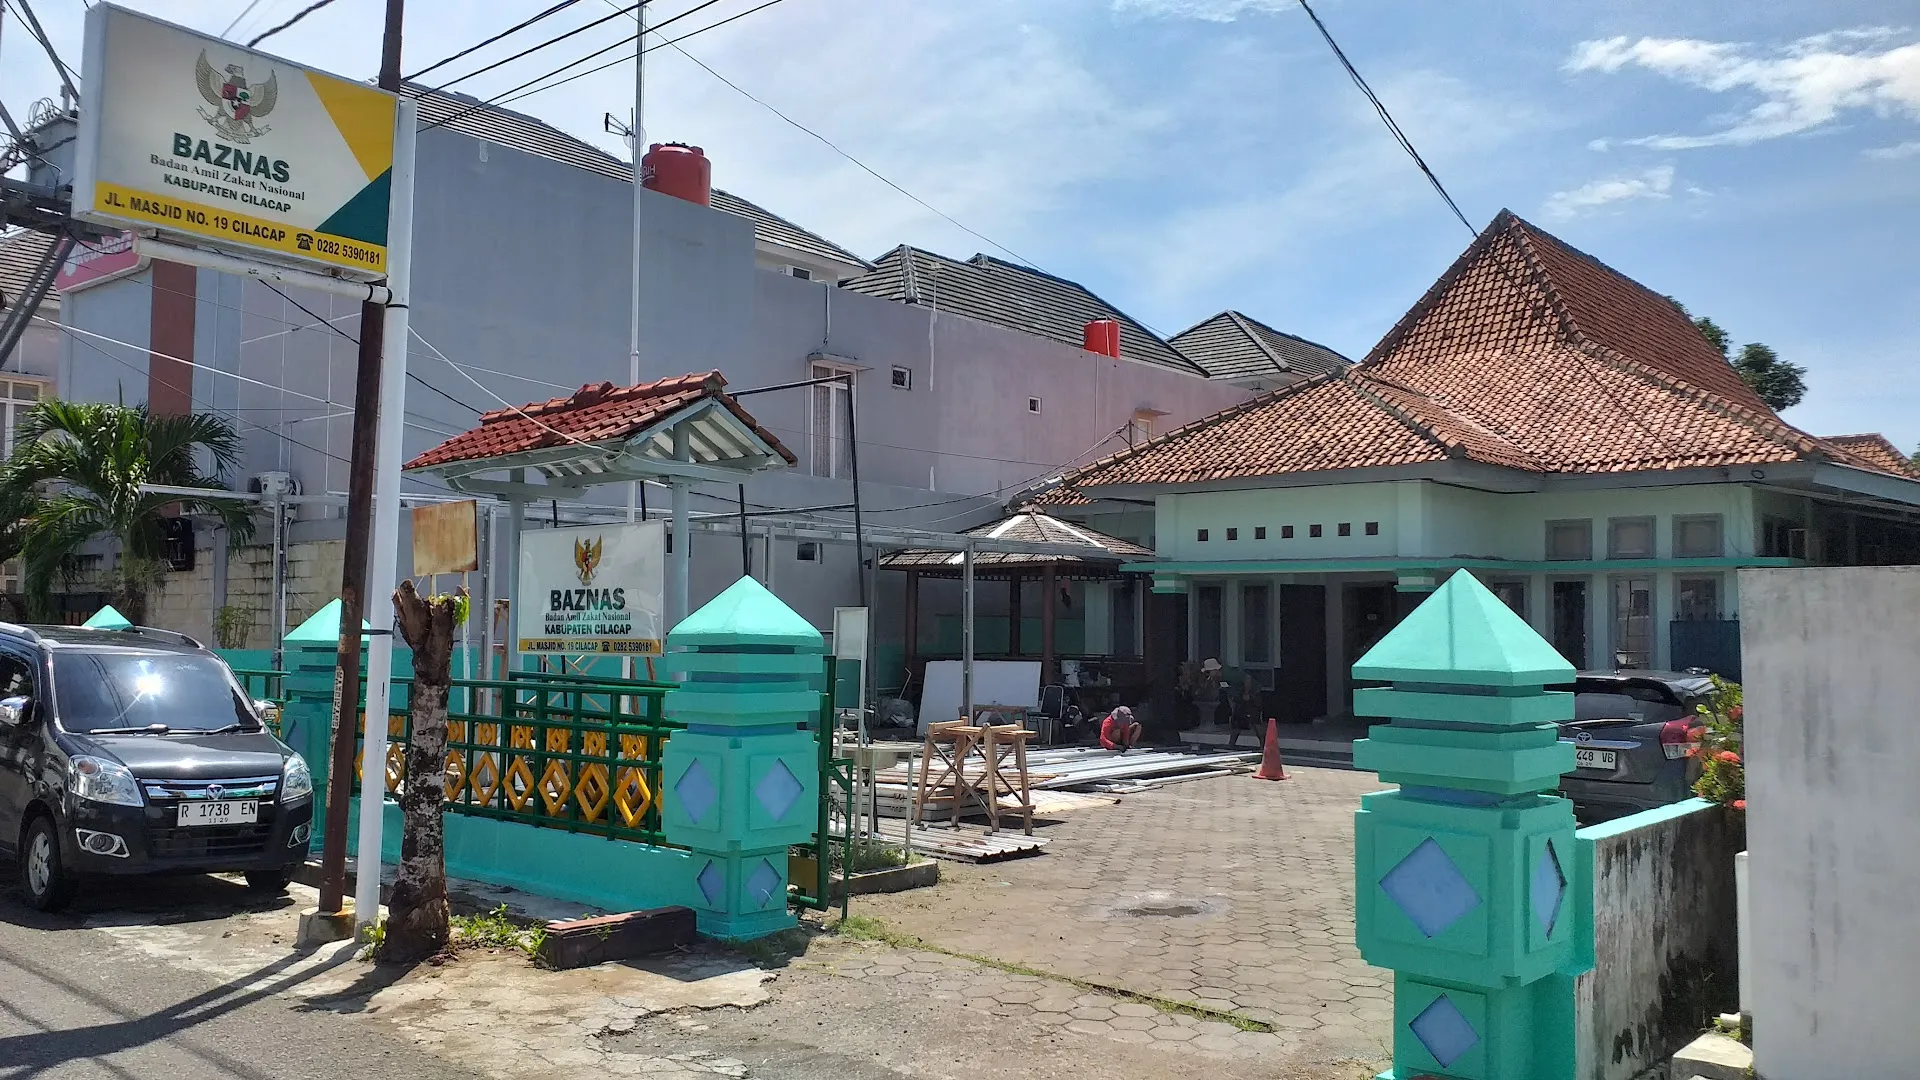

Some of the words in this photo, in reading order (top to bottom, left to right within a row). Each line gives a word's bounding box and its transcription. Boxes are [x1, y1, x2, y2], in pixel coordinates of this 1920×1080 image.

[172, 132, 290, 183] BAZNAS
[150, 153, 188, 172] Badan
[190, 165, 219, 180] Amil
[223, 171, 256, 189] Zakat
[259, 181, 305, 201] Nasional
[163, 173, 238, 200] KABUPATEN
[240, 193, 292, 213] CILACAP
[104, 192, 125, 207] JL.
[130, 196, 182, 220] MASJID
[186, 209, 209, 226] NO.
[213, 215, 229, 230] 19
[232, 219, 286, 242] CILACAP
[317, 238, 340, 256] 0282
[342, 244, 381, 265] 5390181
[550, 587, 626, 611] BAZNAS
[545, 612, 565, 622] Badan
[566, 612, 581, 621] Amil
[582, 612, 601, 621] Zakat
[602, 611, 631, 621] Nasional
[544, 624, 592, 635] KABUPATEN
[594, 623, 632, 635] CILACAP
[527, 641, 536, 650] JL.
[536, 641, 556, 651] MASJID
[575, 641, 599, 651] CILACAP
[1602, 753, 1614, 763] VB
[181, 805, 189, 818] R
[199, 803, 230, 817] 1738
[241, 803, 256, 815] EN
